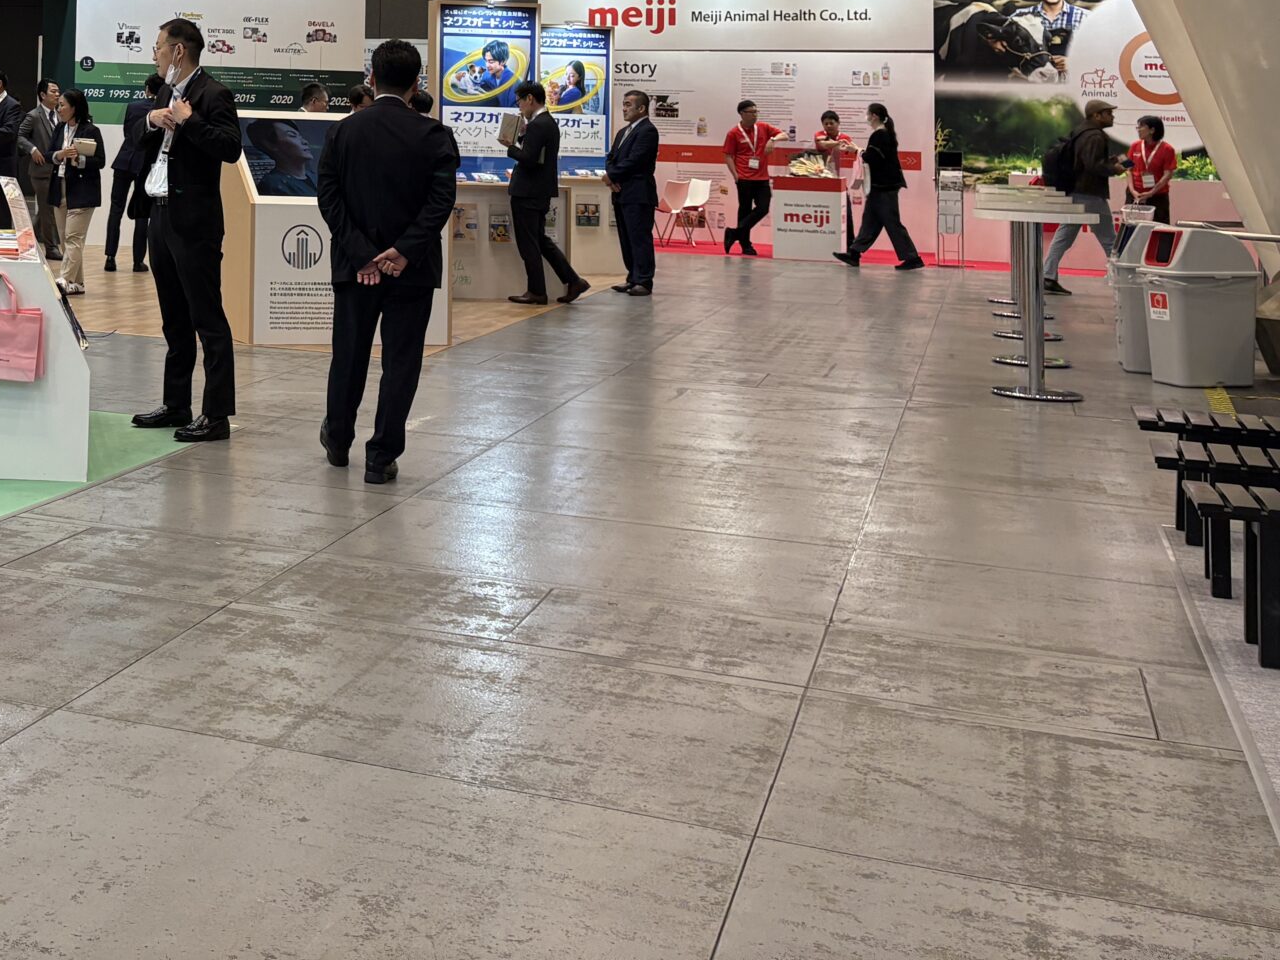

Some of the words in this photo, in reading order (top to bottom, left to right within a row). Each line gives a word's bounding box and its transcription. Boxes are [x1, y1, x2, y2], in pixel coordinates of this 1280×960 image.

[691, 10, 722, 25] Meiji
[724, 9, 770, 23] Animal
[773, 9, 816, 22] Health
[846, 8, 871, 21] Ltd.
[83, 88, 105, 99] 1985
[109, 89, 131, 99] 1995
[234, 93, 256, 103] 2015
[270, 94, 294, 105] 2020
[1081, 89, 1118, 97] Animals
[450, 111, 502, 124] ネクスガ
[783, 210, 830, 227] meiji
